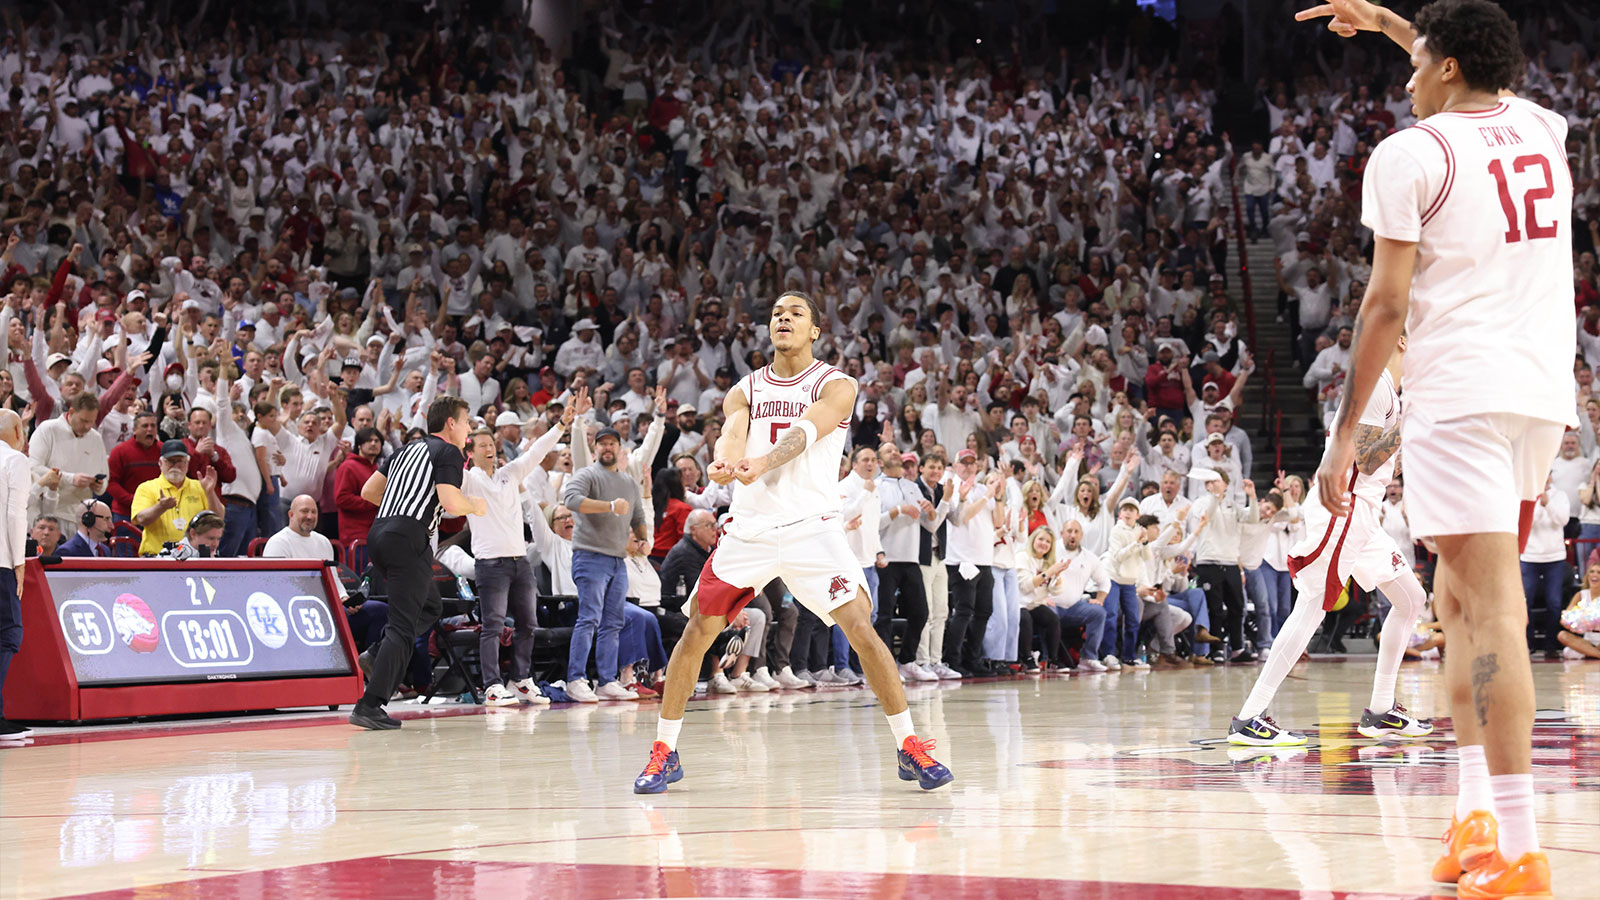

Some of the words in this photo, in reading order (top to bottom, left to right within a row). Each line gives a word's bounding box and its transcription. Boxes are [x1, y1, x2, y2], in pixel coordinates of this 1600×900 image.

[1478, 126, 1523, 147] EWIN
[1487, 153, 1558, 243] 12
[750, 401, 809, 420] RAZORBACK
[186, 577, 202, 605] 2
[72, 612, 102, 646] 55
[251, 606, 283, 635] UK
[299, 608, 325, 639] 53
[178, 619, 239, 659] 13:01
